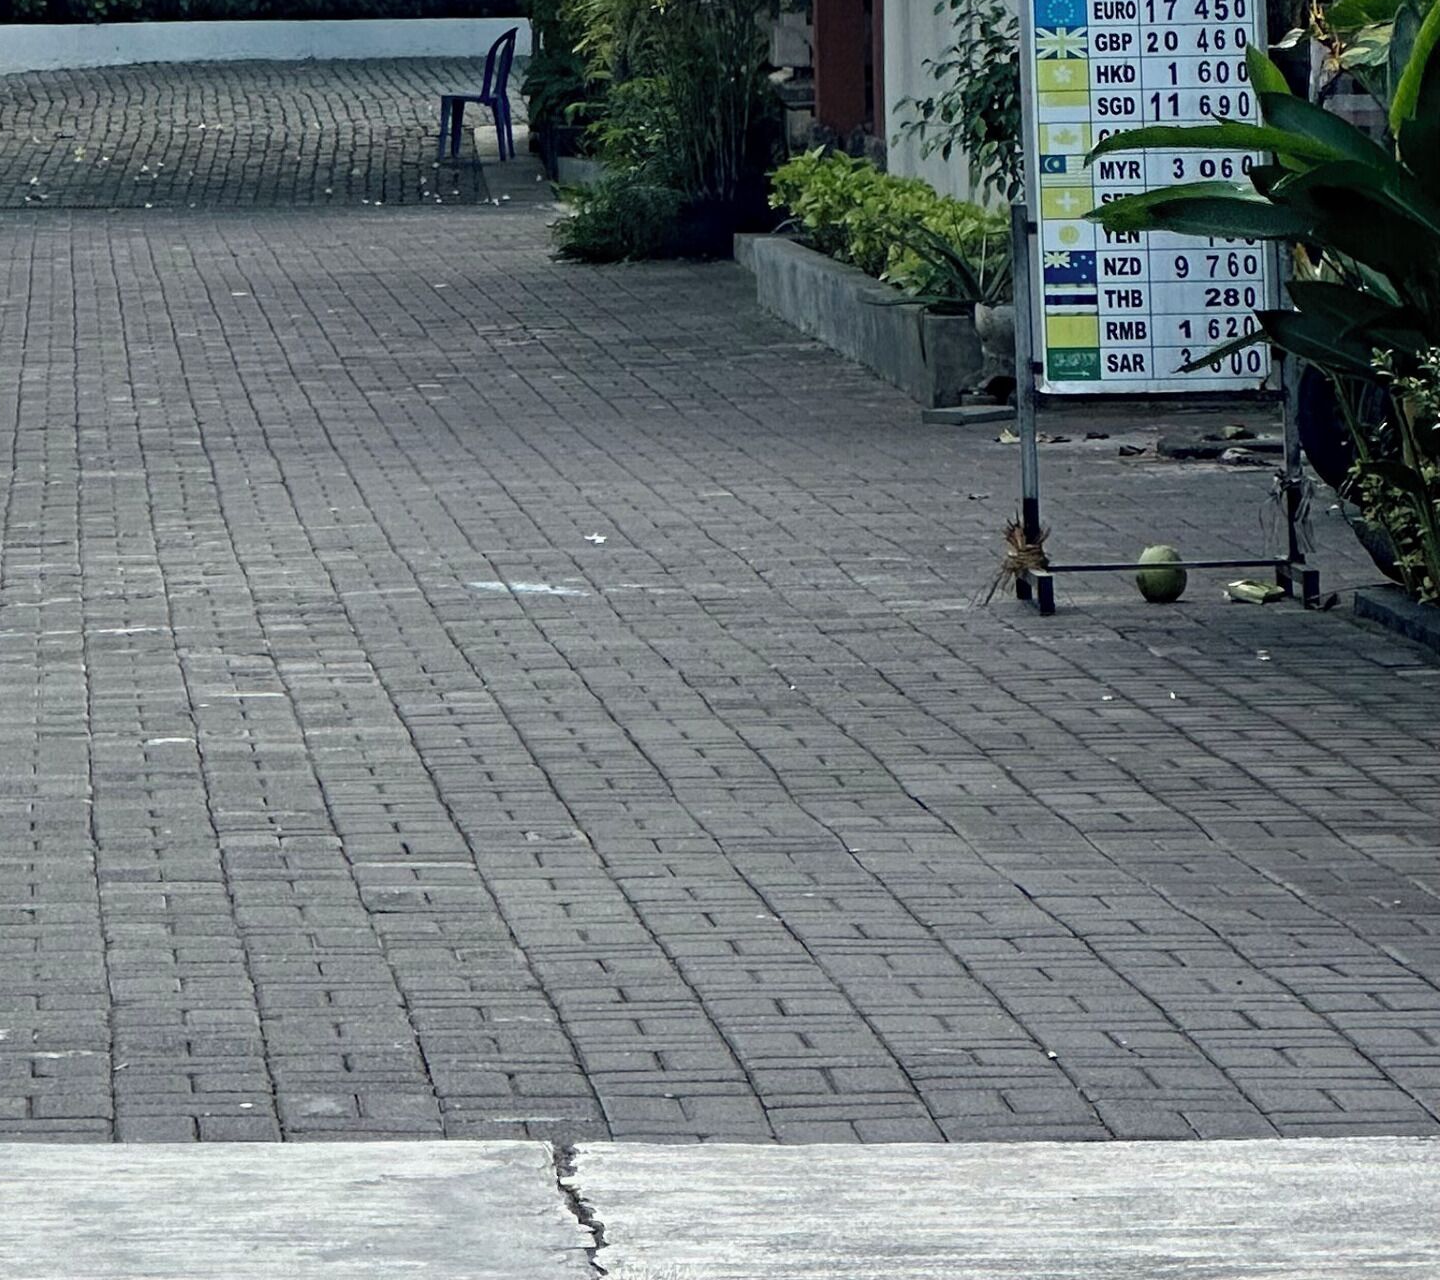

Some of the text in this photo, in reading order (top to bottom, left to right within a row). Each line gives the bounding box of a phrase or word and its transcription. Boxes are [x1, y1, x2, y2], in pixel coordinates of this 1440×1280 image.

[1093, 1, 1137, 19] EURO
[1094, 33, 1133, 52] GBP
[1096, 65, 1136, 83] HKD
[1097, 96, 1135, 115] SGD
[1099, 160, 1141, 180] MYR
[1103, 257, 1142, 276] NZD
[1104, 286, 1256, 308] THB 280
[1106, 321, 1147, 340] RMB
[1107, 353, 1145, 372] SAR
